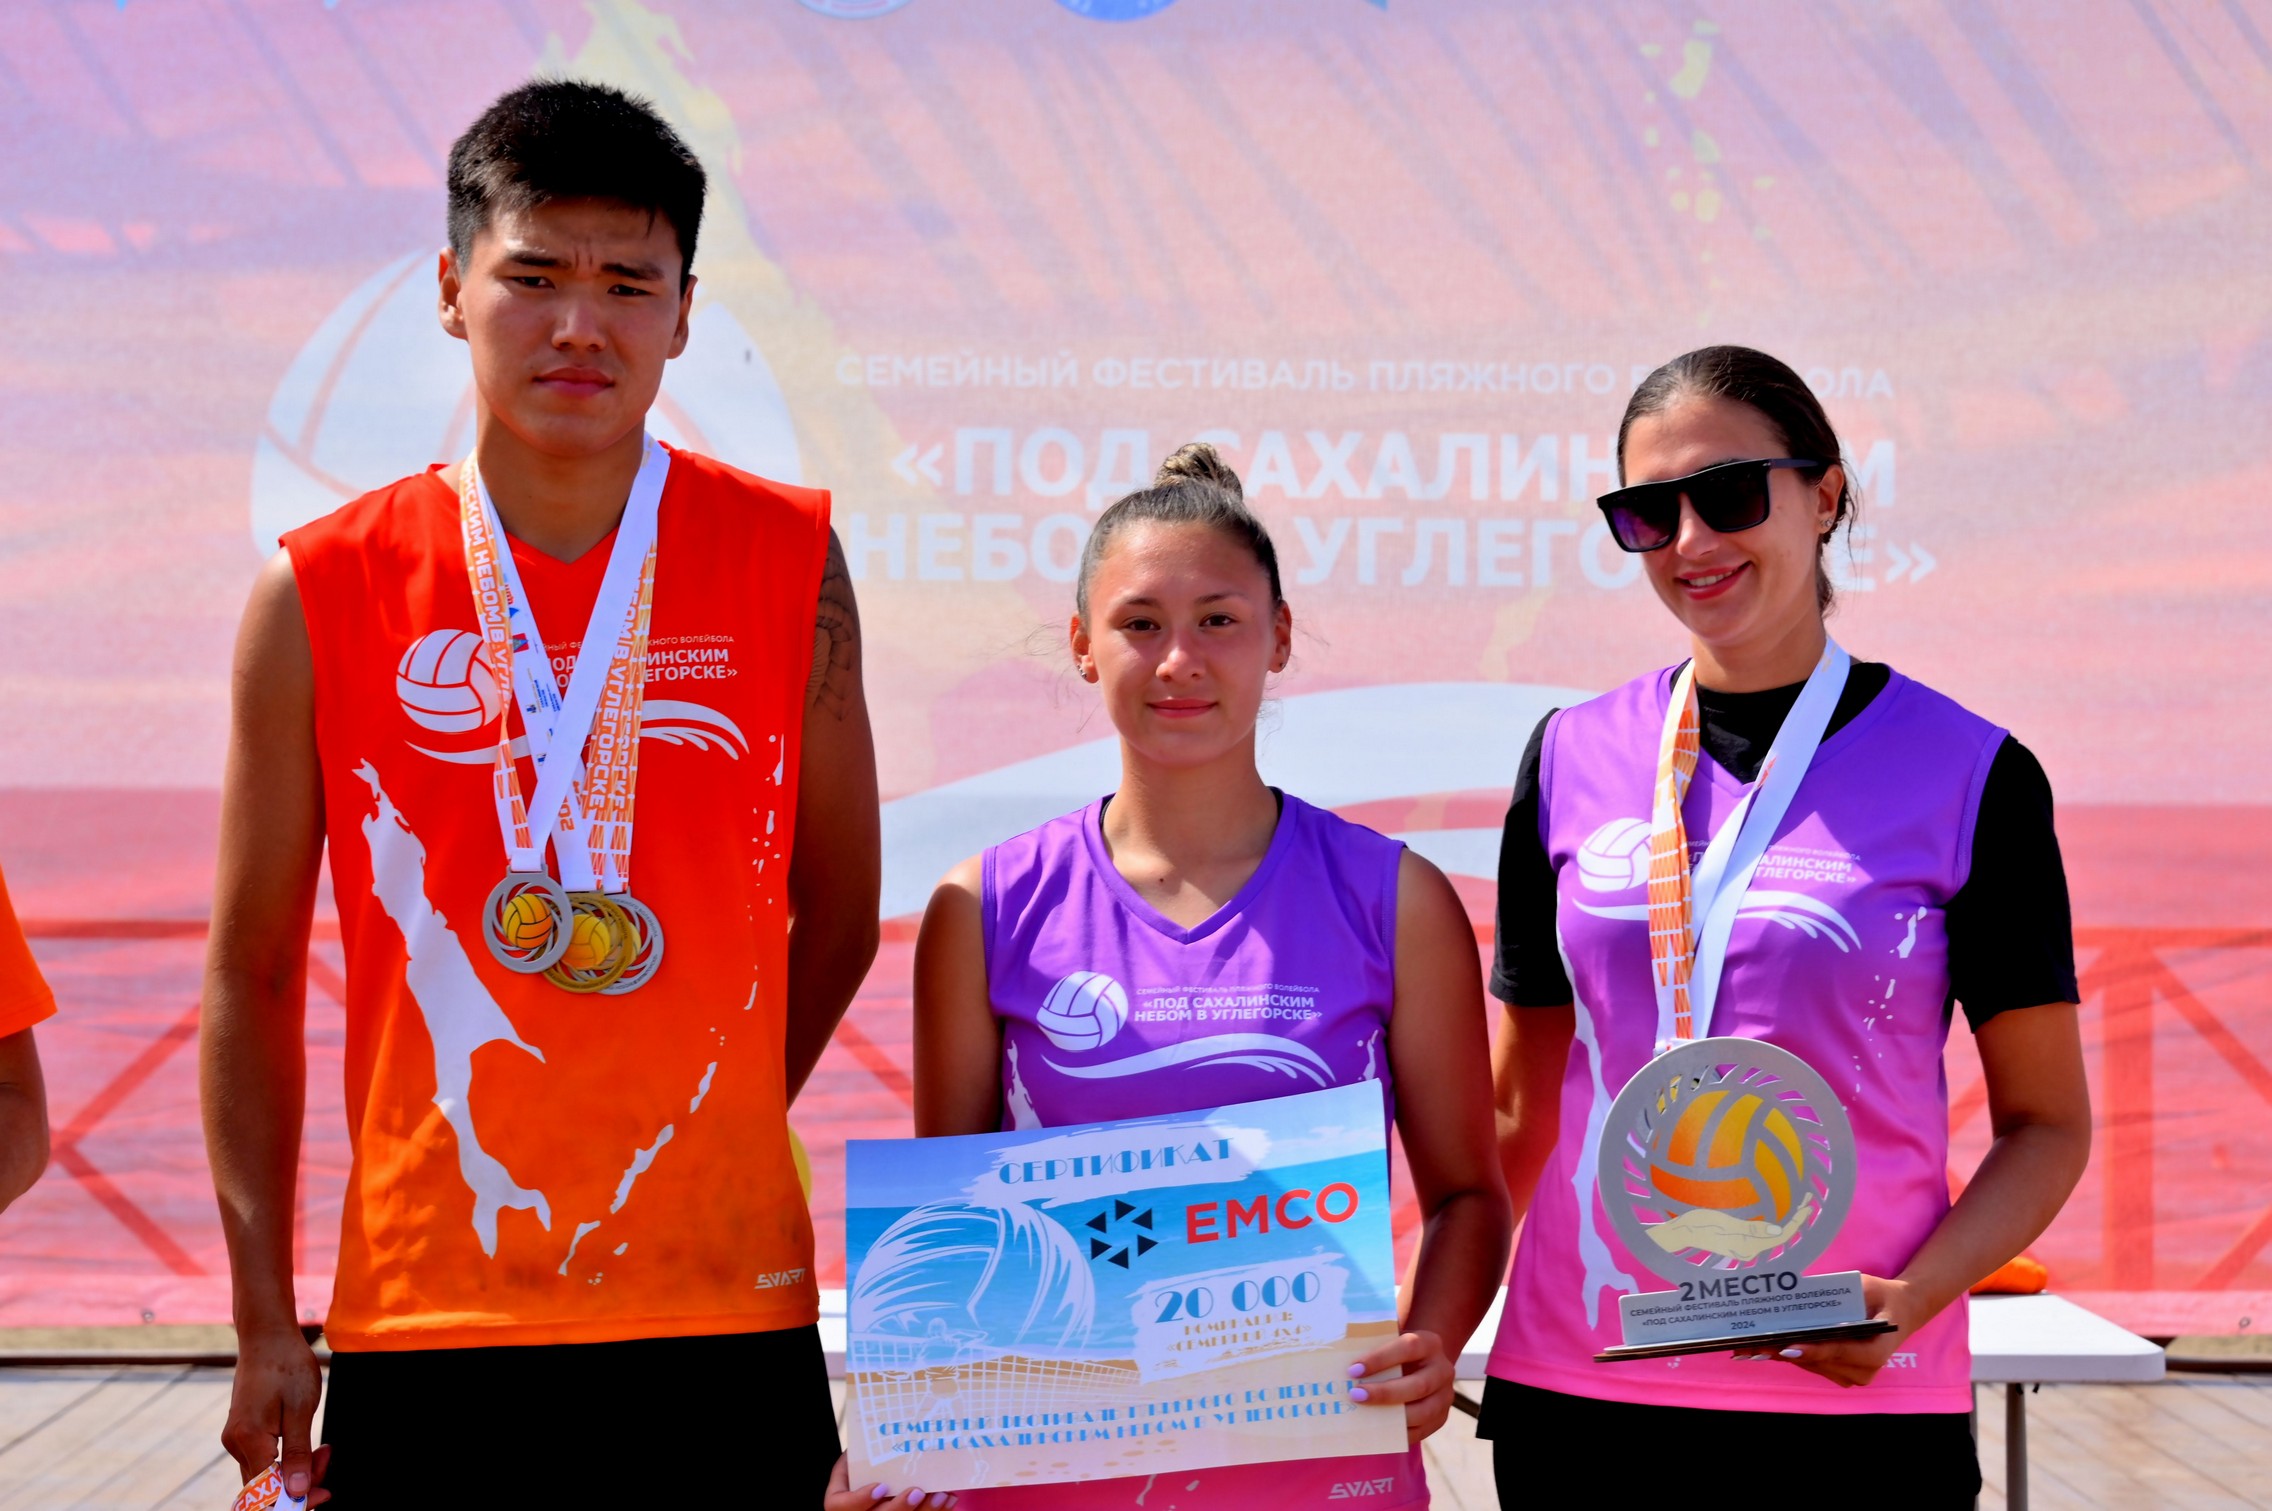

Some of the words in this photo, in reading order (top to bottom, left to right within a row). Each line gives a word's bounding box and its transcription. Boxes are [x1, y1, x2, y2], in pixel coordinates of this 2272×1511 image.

[835, 348, 1080, 388] СЕМЕЙНЫЙ
[1091, 357, 1357, 391] ФЕСТИВАЛЬ
[1369, 360, 1617, 395] ПЛЯЖНОГО
[890, 425, 1149, 511] «ПОД
[849, 511, 1092, 583] НЕБО
[680, 634, 735, 644] ВОЛЕЙБОЛА
[647, 648, 729, 666] ИНСКИМ
[644, 665, 738, 683] ЕГОРСКЕ»
[1755, 867, 1857, 884] ГЛЕГОРСКЕ»
[1143, 996, 1190, 1010] «ПОД
[1192, 993, 1315, 1009] САХАЛИНСКИМ
[1134, 1008, 1192, 1022] НЕБОМ
[1196, 1009, 1208, 1021] В
[1211, 1007, 1323, 1021] УГЛЕГОРСКЕ»
[999, 1137, 1235, 1184] СЕРТИФИКАТ
[1186, 1181, 1359, 1244] EMCO
[754, 1267, 807, 1290] SVART
[1154, 1286, 1214, 1324] 20
[1231, 1271, 1321, 1312] 000
[1630, 1304, 1682, 1317] СЕМЕЙНЫЙ
[1684, 1299, 1740, 1312] ФЕСТИВАЛЬ
[1741, 1294, 1794, 1306] ПЛЯЖНОГО
[1795, 1288, 1852, 1300] ВОЛЕЙБОЛА
[1642, 1318, 1667, 1327] «ПОД
[1668, 1311, 1738, 1324] САХАЛИНСКИМ
[1739, 1307, 1772, 1317] НЕБОМ
[1774, 1305, 1781, 1313] В
[1781, 1300, 1842, 1313] УГЛЕГОРСКЕ»
[1731, 1320, 1757, 1330] 2024
[1327, 1477, 1395, 1500] SVART
